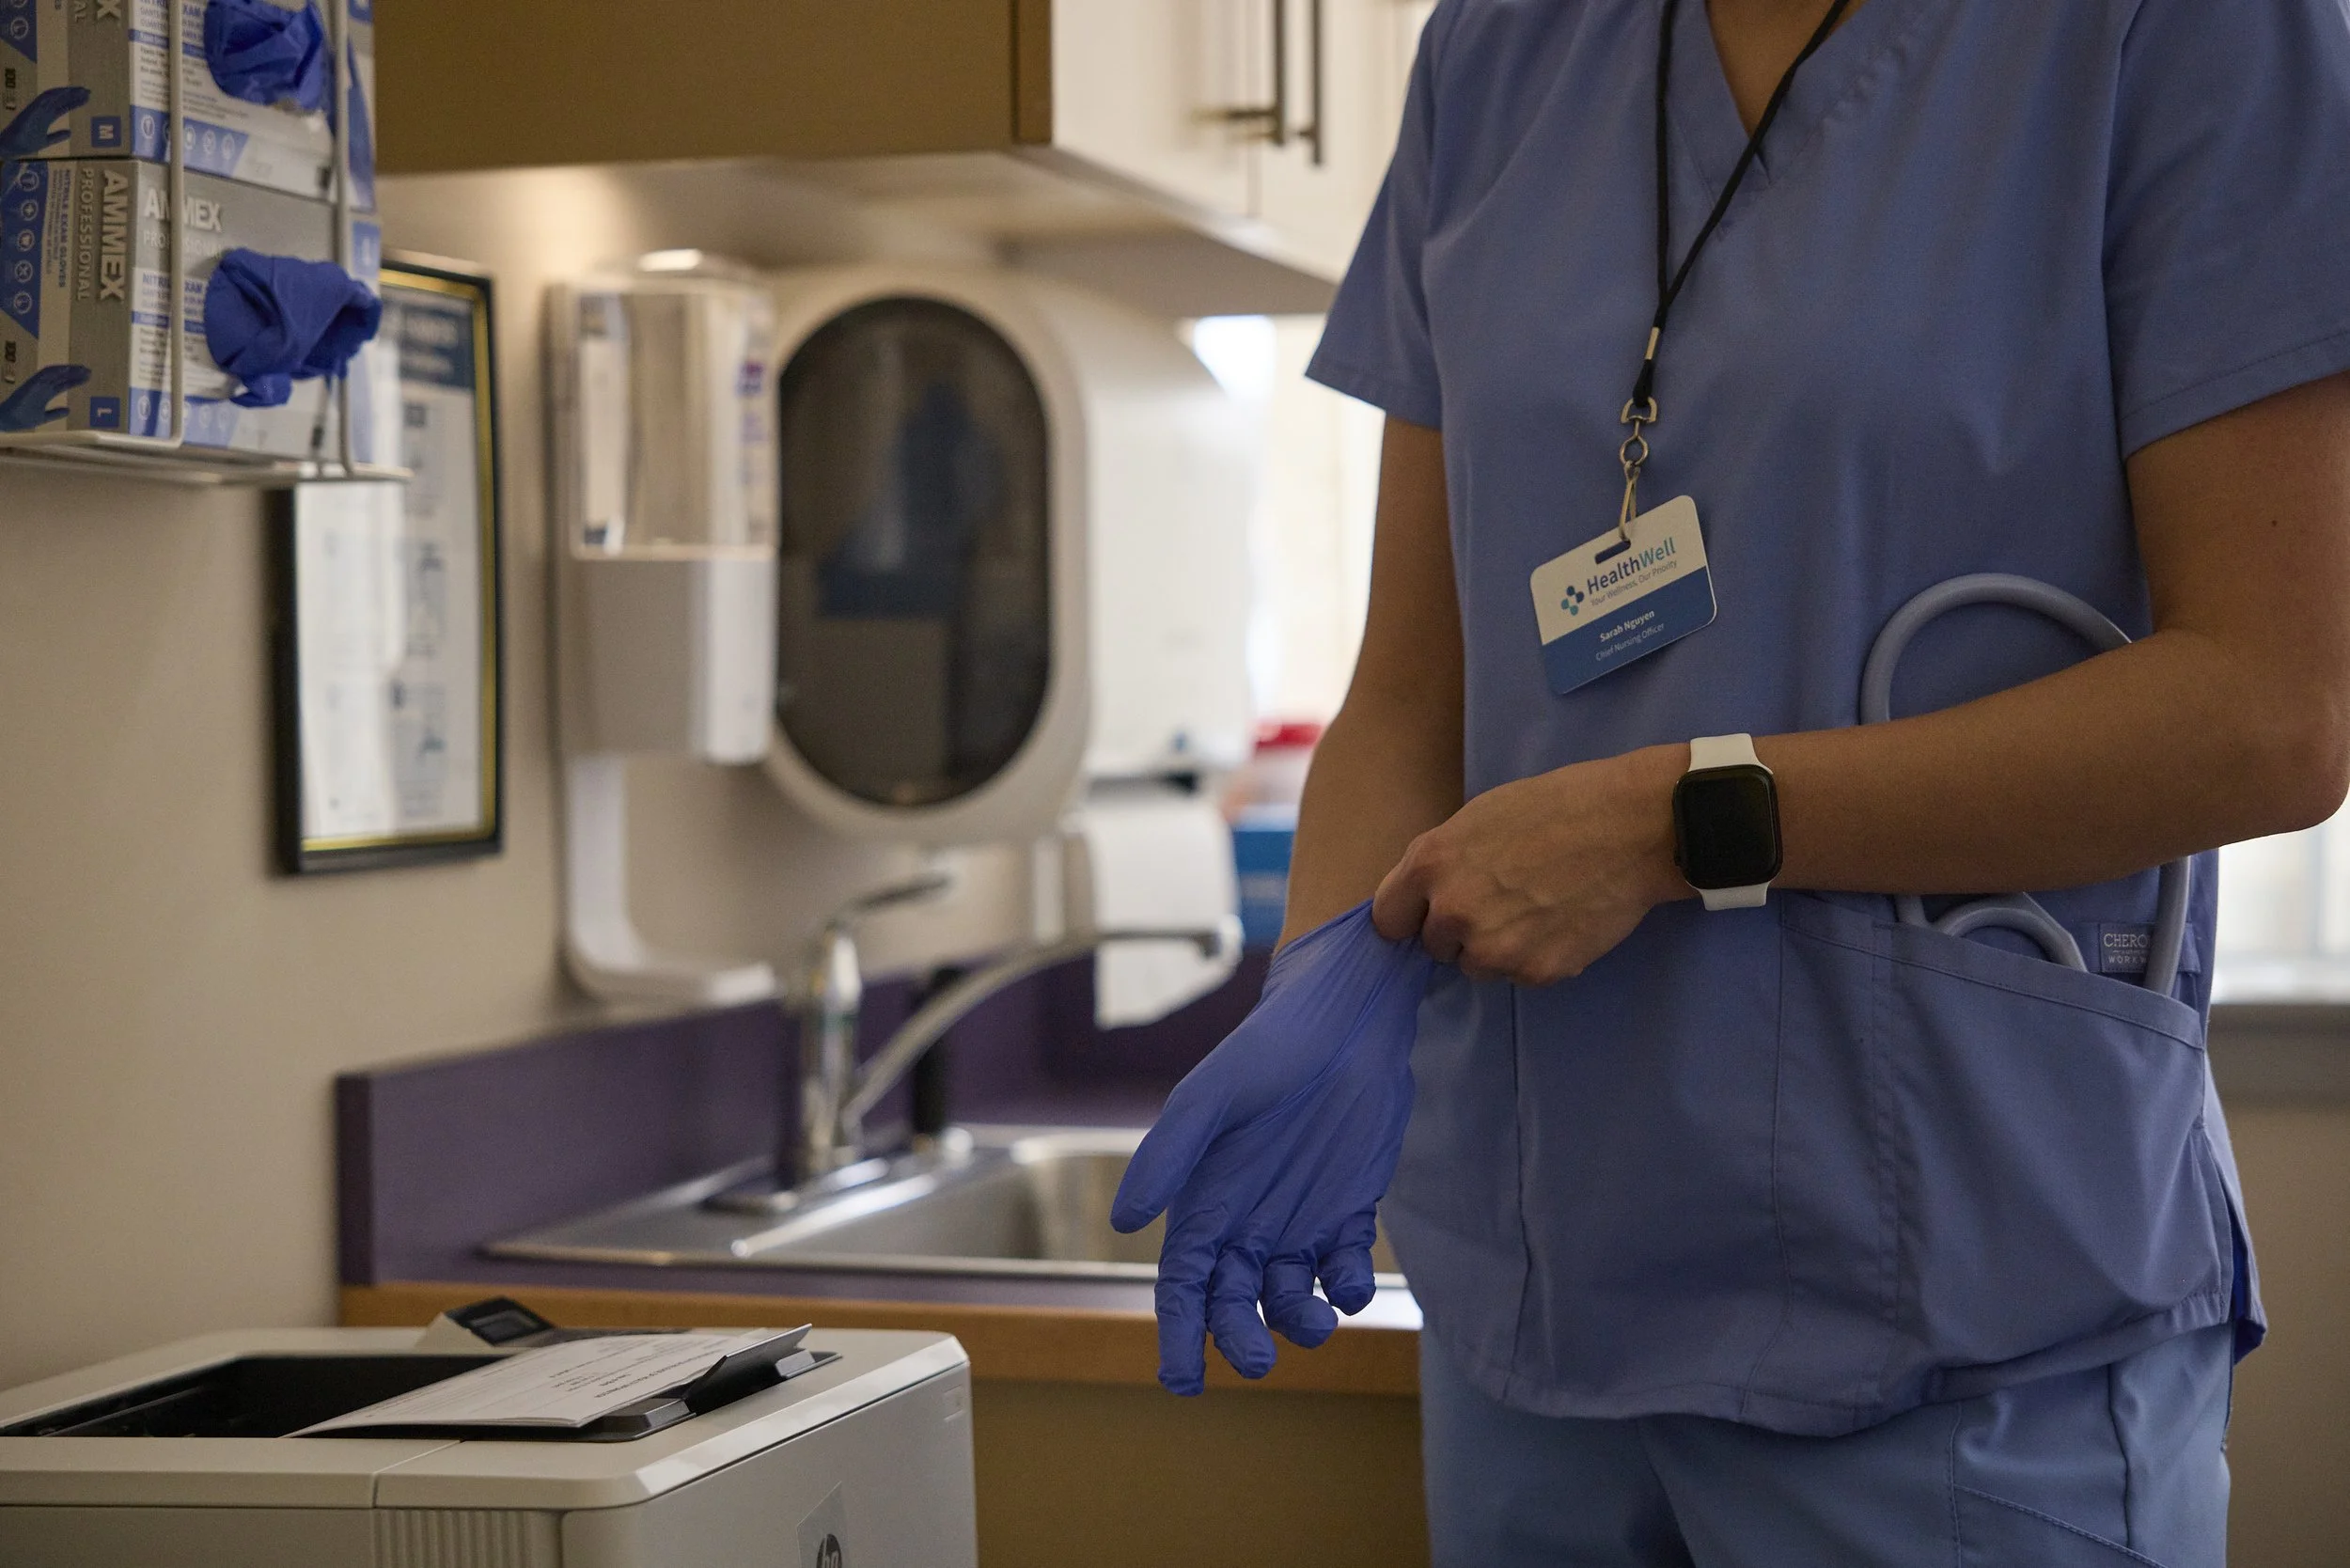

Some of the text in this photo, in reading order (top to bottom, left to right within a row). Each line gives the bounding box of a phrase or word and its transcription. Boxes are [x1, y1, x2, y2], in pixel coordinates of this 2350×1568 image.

[99, 124, 114, 139] M
[77, 168, 94, 300] PROFESSIONAL
[100, 169, 129, 300] AMMEX
[97, 407, 112, 418] L
[1587, 537, 1676, 595] HealthWell
[1638, 572, 1651, 583] Our
[1652, 560, 1677, 576] Priority
[1595, 622, 1665, 662] Chief Nursing Officer
[1600, 610, 1655, 643] Sarah Nguyen
[2104, 933, 2148, 948] CHERO
